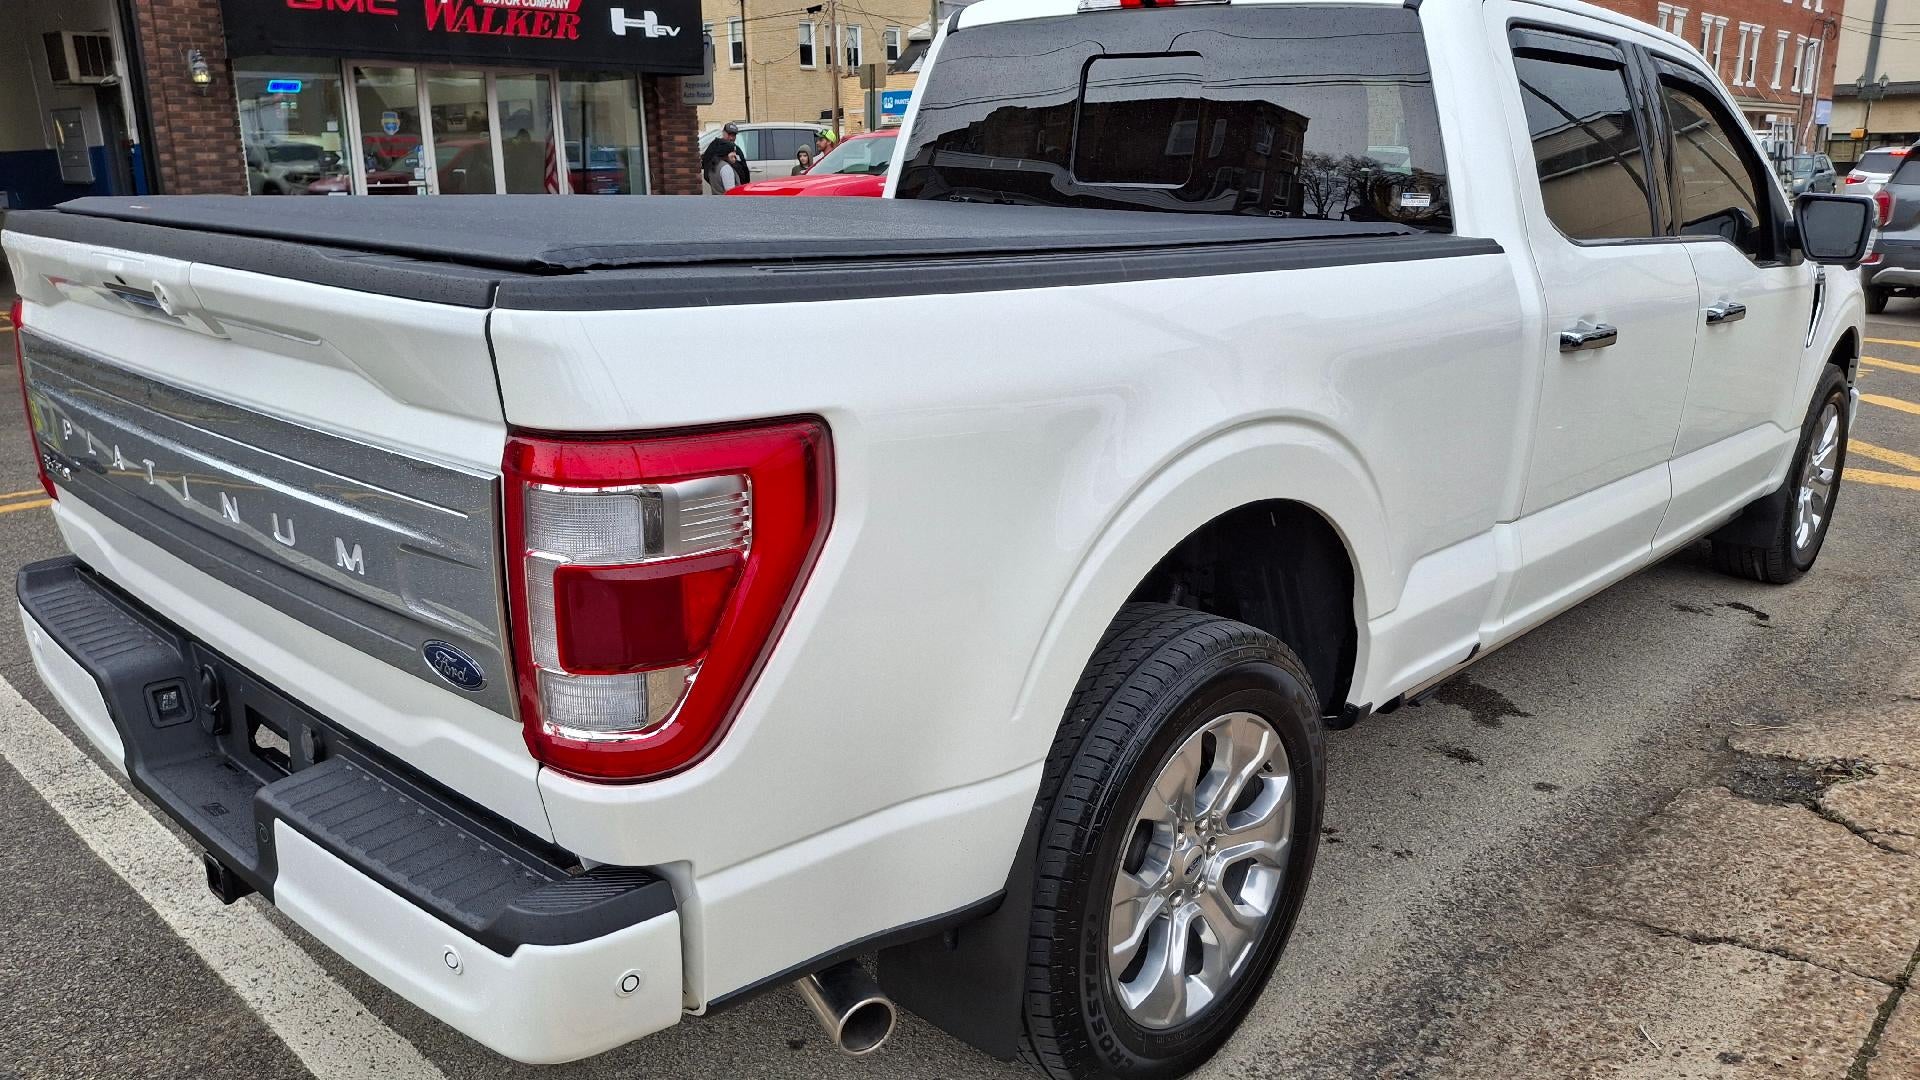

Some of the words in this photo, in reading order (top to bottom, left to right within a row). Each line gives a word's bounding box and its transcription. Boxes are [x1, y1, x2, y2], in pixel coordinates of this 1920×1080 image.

[424, 0, 582, 40] WALKER
[523, 0, 570, 9] COMPANY
[63, 418, 365, 576] PLATINUM
[434, 650, 468, 682] Ford
